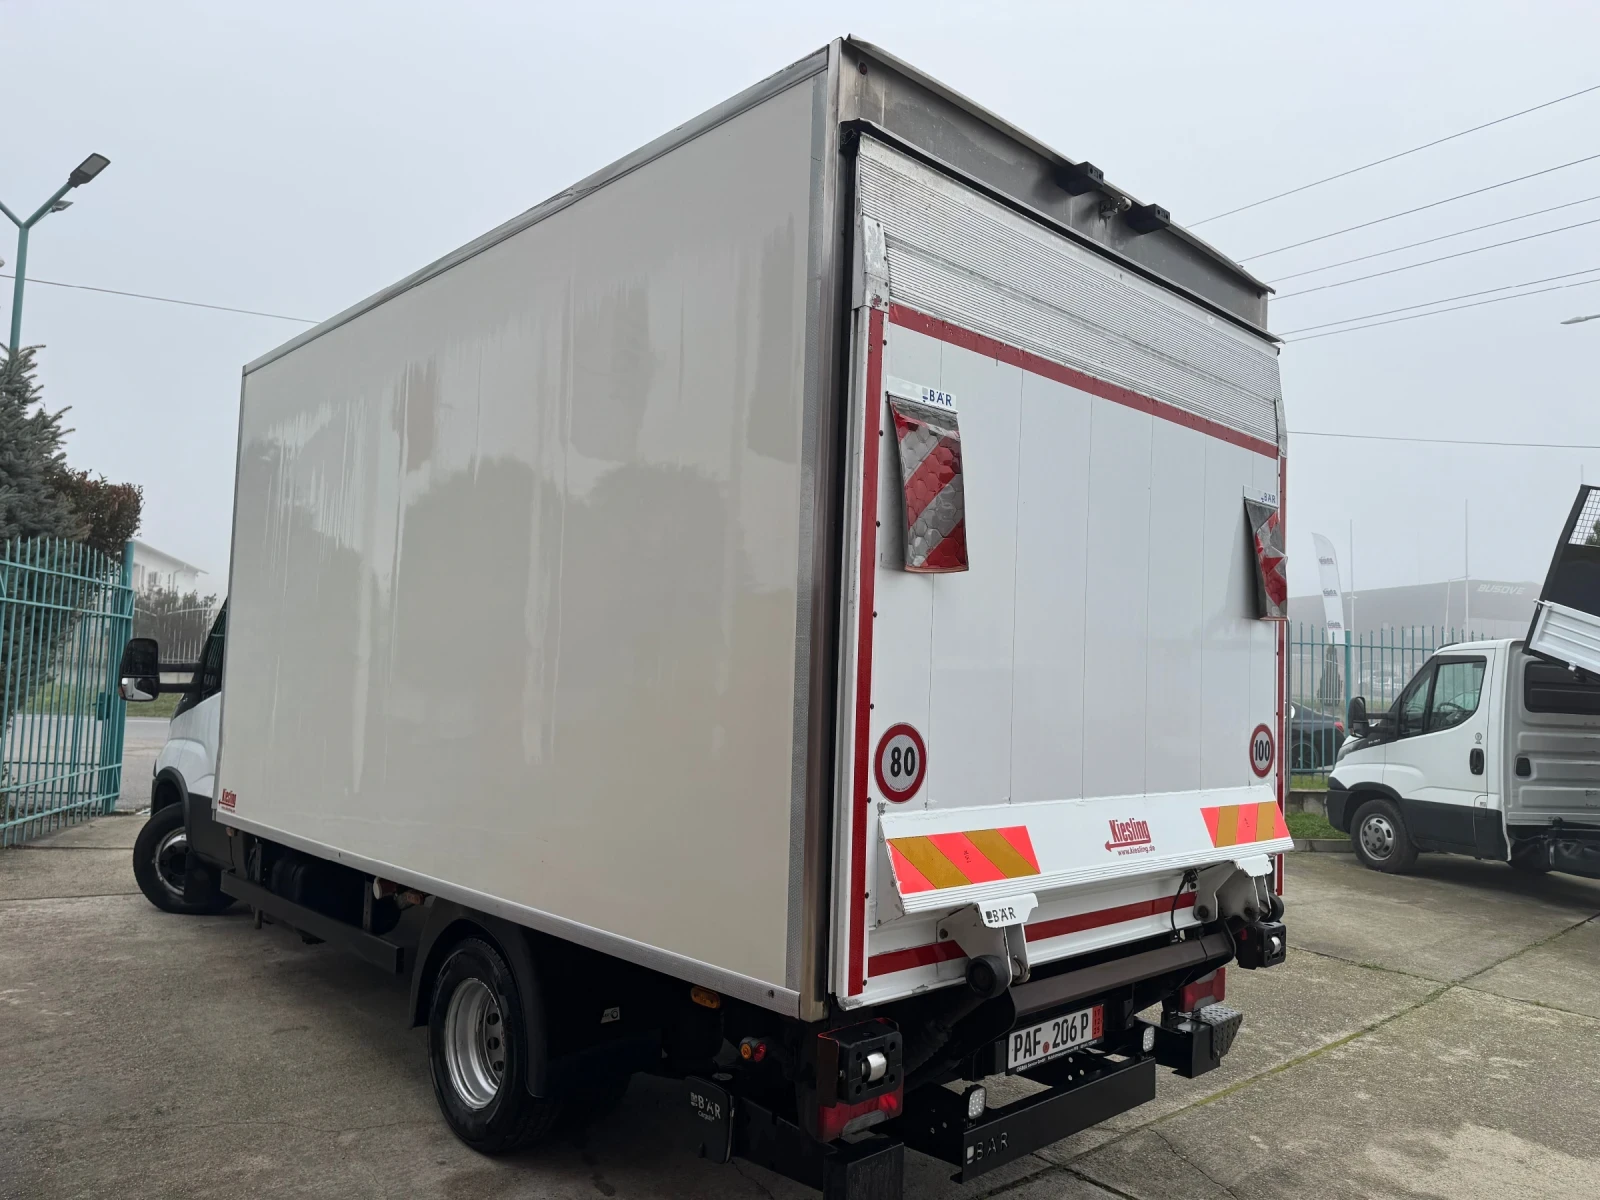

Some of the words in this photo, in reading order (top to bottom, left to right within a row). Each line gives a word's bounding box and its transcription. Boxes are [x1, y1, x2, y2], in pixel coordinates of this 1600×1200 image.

[929, 389, 952, 406] BÄR
[890, 746, 916, 778] 80
[1254, 739, 1271, 762] 100
[1108, 817, 1151, 843] Kiesling
[1117, 845, 1156, 856] www.kiesling.de
[992, 906, 1017, 923] BÄR
[1013, 1027, 1042, 1063] PAF
[1052, 1015, 1077, 1049] 206
[1080, 1012, 1089, 1039] P
[697, 1094, 721, 1119] BÄR
